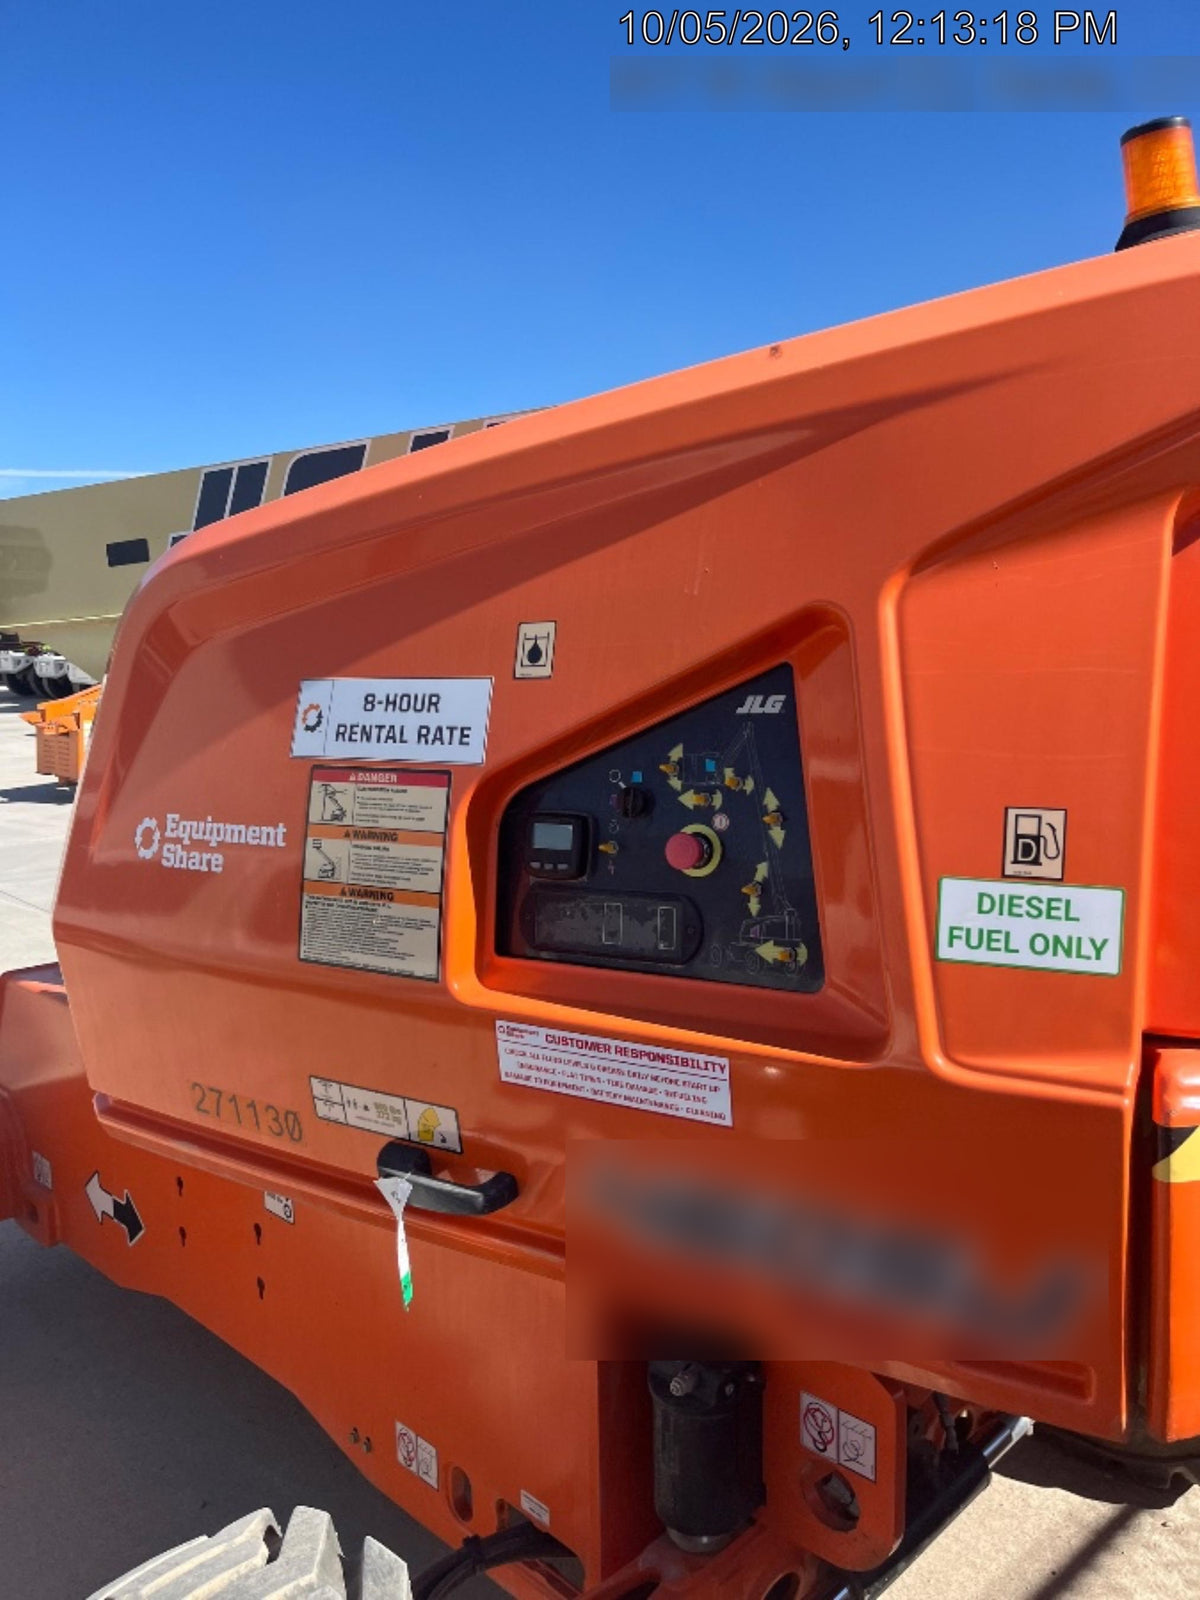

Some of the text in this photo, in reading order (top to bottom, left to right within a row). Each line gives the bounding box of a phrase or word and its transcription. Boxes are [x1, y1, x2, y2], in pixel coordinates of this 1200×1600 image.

[363, 692, 442, 713] 8-HOUR
[736, 695, 786, 714] JLG
[335, 724, 473, 746] RENTAL RATE
[357, 773, 398, 783] DANGER
[164, 813, 287, 847] Equipment
[352, 830, 399, 842] WARNING
[161, 843, 224, 873] Share
[348, 888, 395, 902] WARNING
[977, 892, 1080, 922] DIESEL
[947, 926, 1109, 961] FUEL ONLY
[545, 1033, 727, 1074] CUSTOMER RESPONSIBILITY
[191, 1082, 303, 1142] 271130
